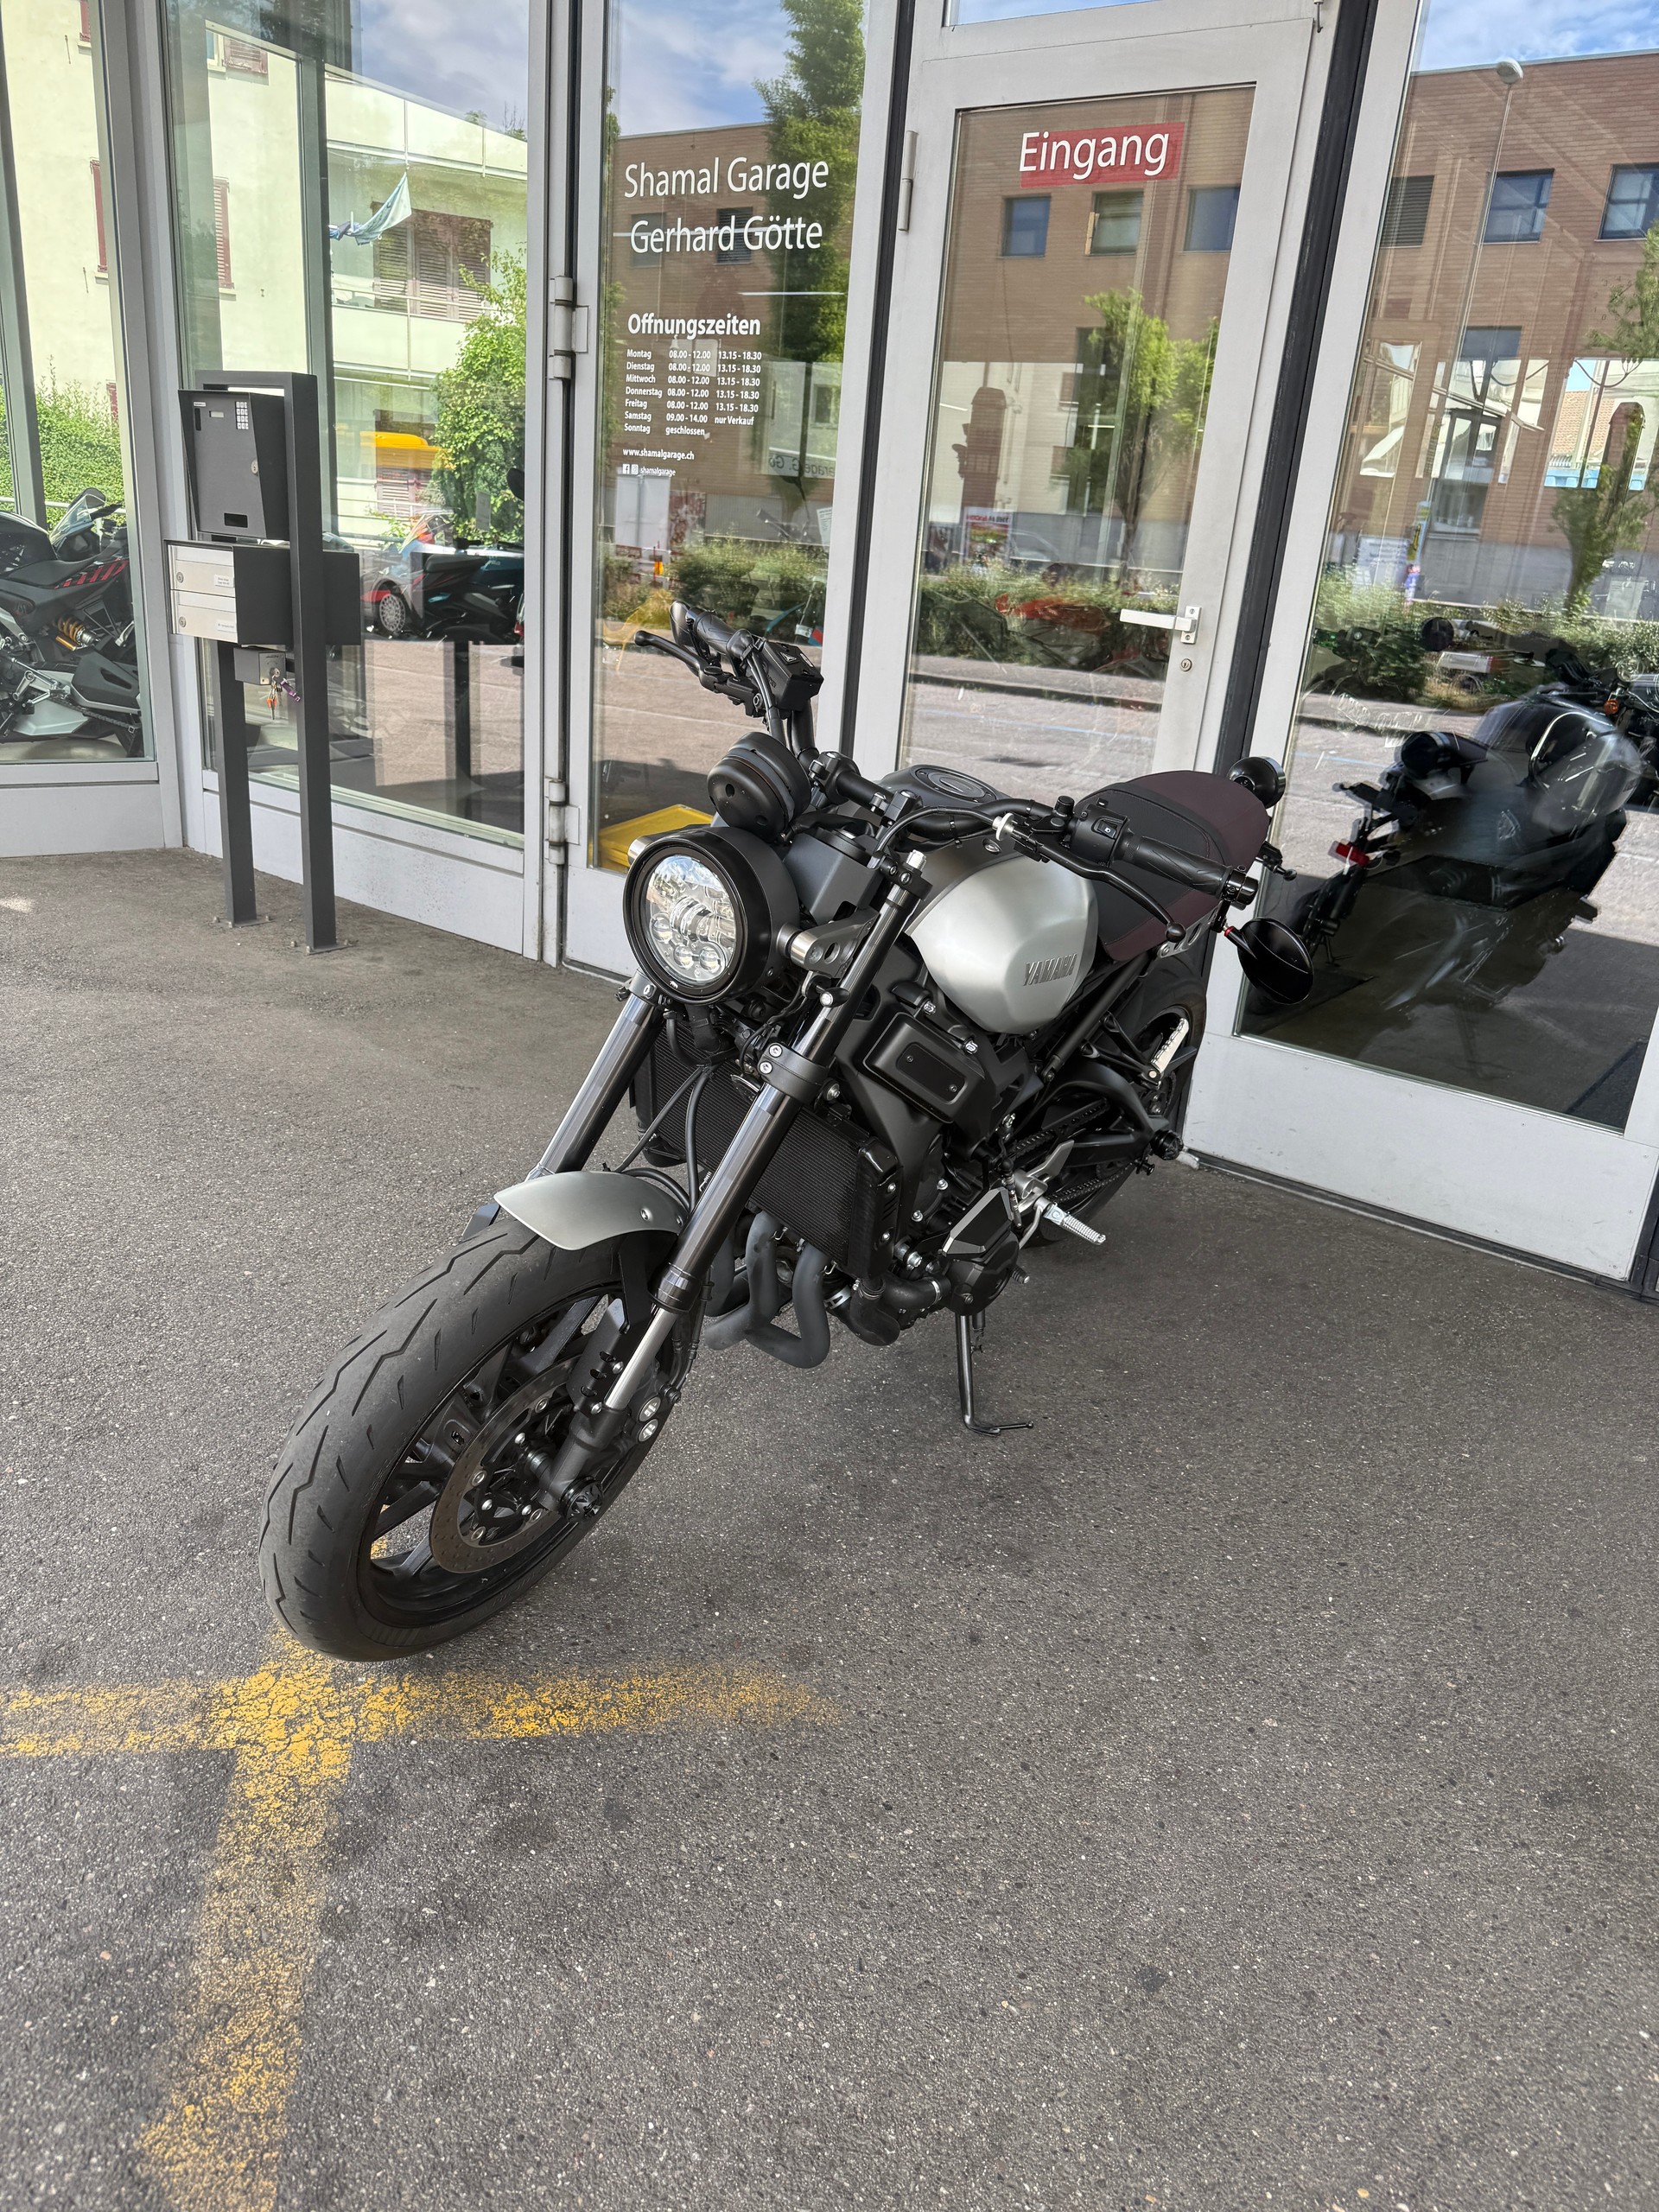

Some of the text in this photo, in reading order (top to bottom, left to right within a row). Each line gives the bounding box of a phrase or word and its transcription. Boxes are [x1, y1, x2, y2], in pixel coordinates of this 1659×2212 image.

[1020, 131, 1169, 180] Eingang
[624, 156, 830, 200] Shamal Garage
[630, 214, 823, 253] Gerhard Götte
[626, 349, 652, 359] Montag
[669, 350, 687, 359] 08.00
[718, 351, 737, 359] 13.15
[743, 352, 761, 360] 18.30
[626, 362, 654, 372] Dienstag
[742, 365, 760, 373] 18.30
[626, 375, 655, 384] Mittwoch
[717, 377, 735, 385] 13.15
[741, 378, 760, 386] 18.30
[626, 387, 662, 397] Donnerstag
[667, 388, 685, 397] 08.00
[691, 389, 709, 397] 12.00
[626, 399, 647, 409] Freitag
[690, 402, 708, 410] 12.00
[716, 403, 734, 411] 13.15
[740, 404, 758, 412] 18.30
[625, 411, 652, 422] Samstag
[728, 416, 754, 425] Verkauf
[625, 423, 705, 435] Sonntag geschlossen
[623, 448, 694, 460] www.shamalgarage.ch
[640, 467, 676, 476] shamalgarage
[1023, 953, 1077, 986] YAMAHA
